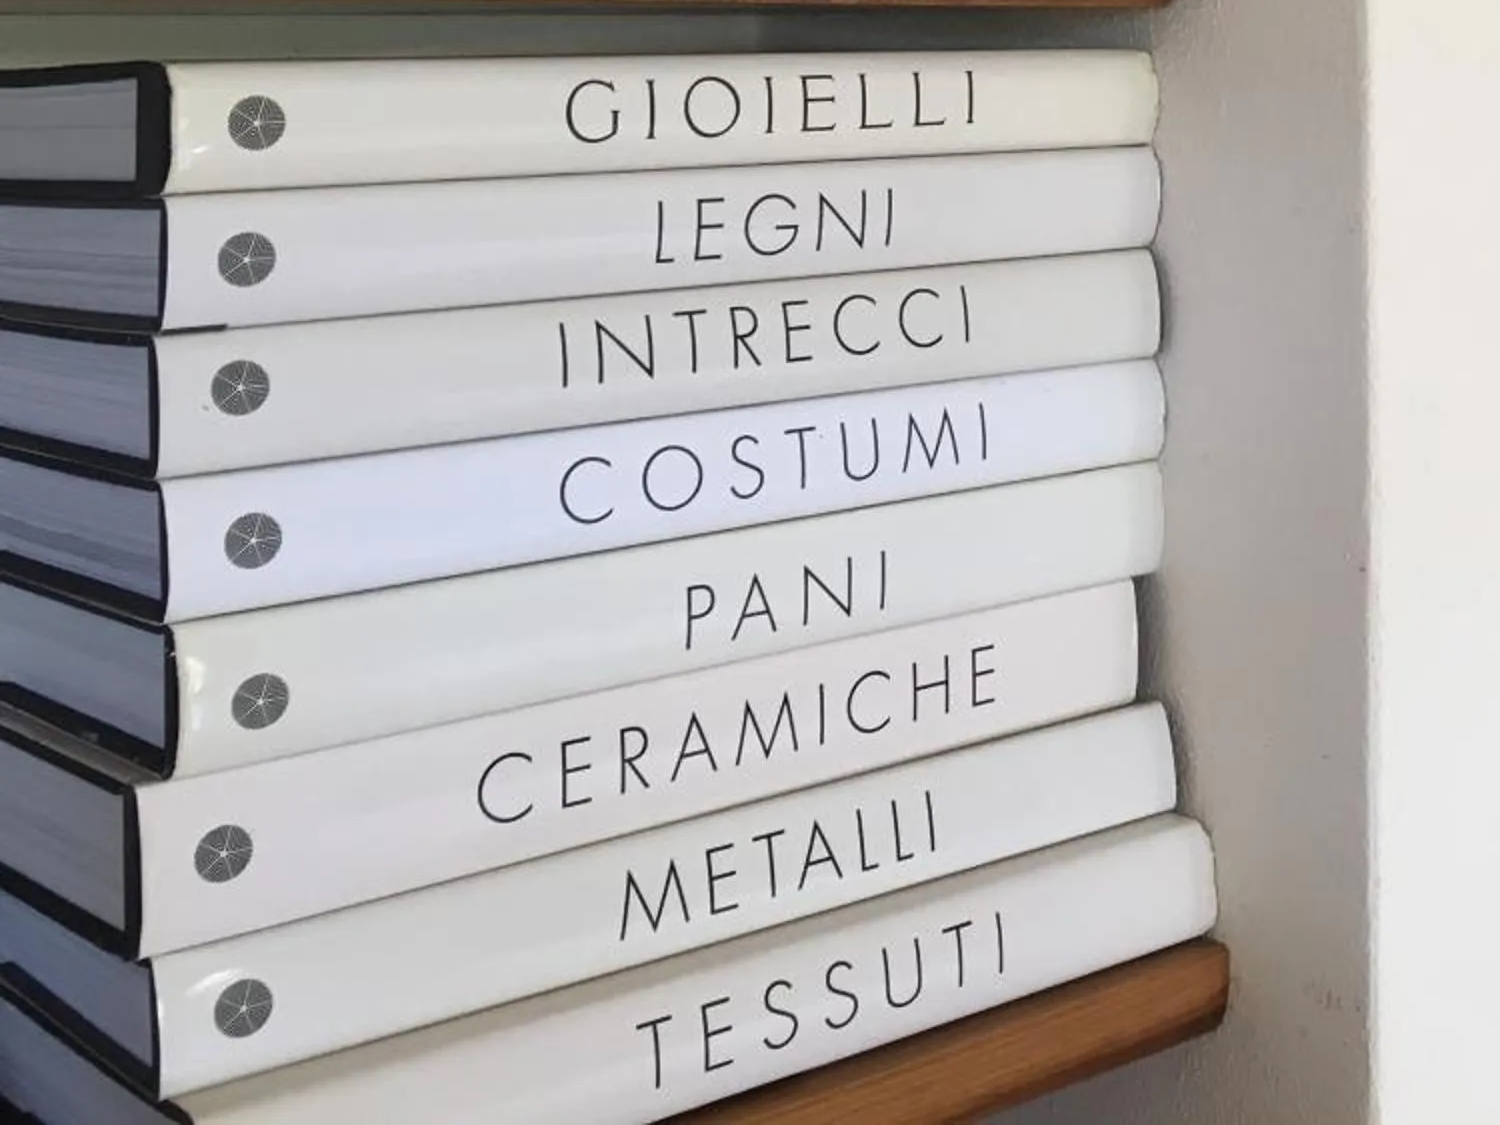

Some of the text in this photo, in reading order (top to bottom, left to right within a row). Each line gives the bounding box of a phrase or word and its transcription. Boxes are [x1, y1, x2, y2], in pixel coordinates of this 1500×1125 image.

[564, 70, 977, 145] GIOIELLI
[654, 187, 896, 264] LEGNI
[557, 285, 971, 389] INTRECCI
[559, 402, 989, 525] COSTUMI
[684, 550, 887, 651] PANI
[476, 644, 997, 824] CERAMICHE
[619, 790, 937, 942] METALLI
[635, 911, 1006, 1089] TESSUTI
